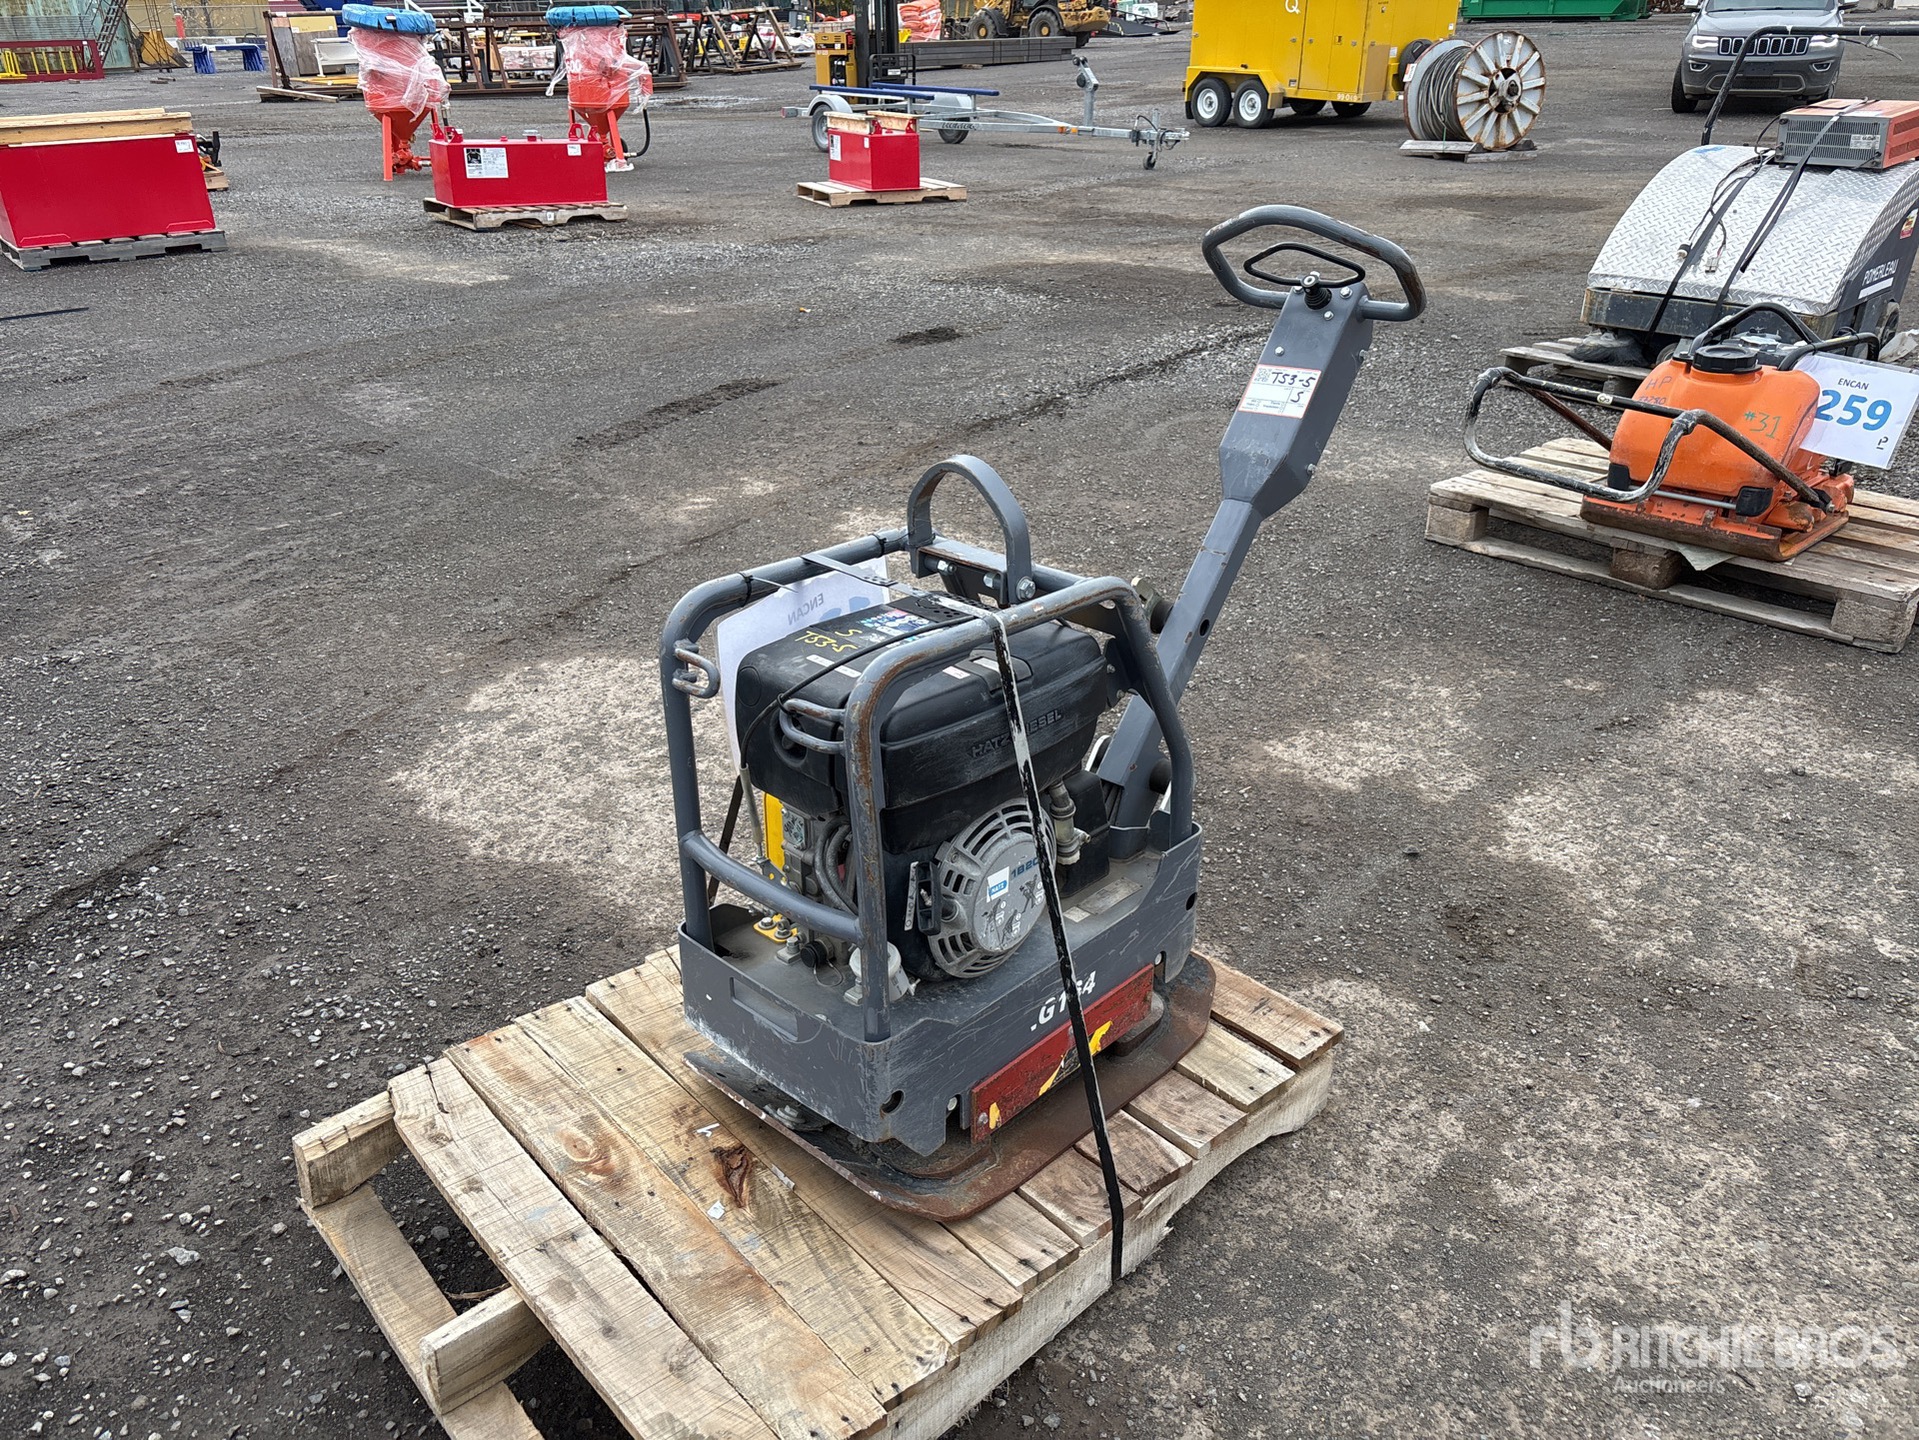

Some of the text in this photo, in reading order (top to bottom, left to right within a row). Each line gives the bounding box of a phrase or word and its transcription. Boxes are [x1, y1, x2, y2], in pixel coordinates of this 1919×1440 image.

[1837, 377, 1869, 390] ENCAN
[1814, 389, 1892, 431] 259
[1744, 411, 1781, 439] #31
[1025, 709, 1062, 736] IESEL
